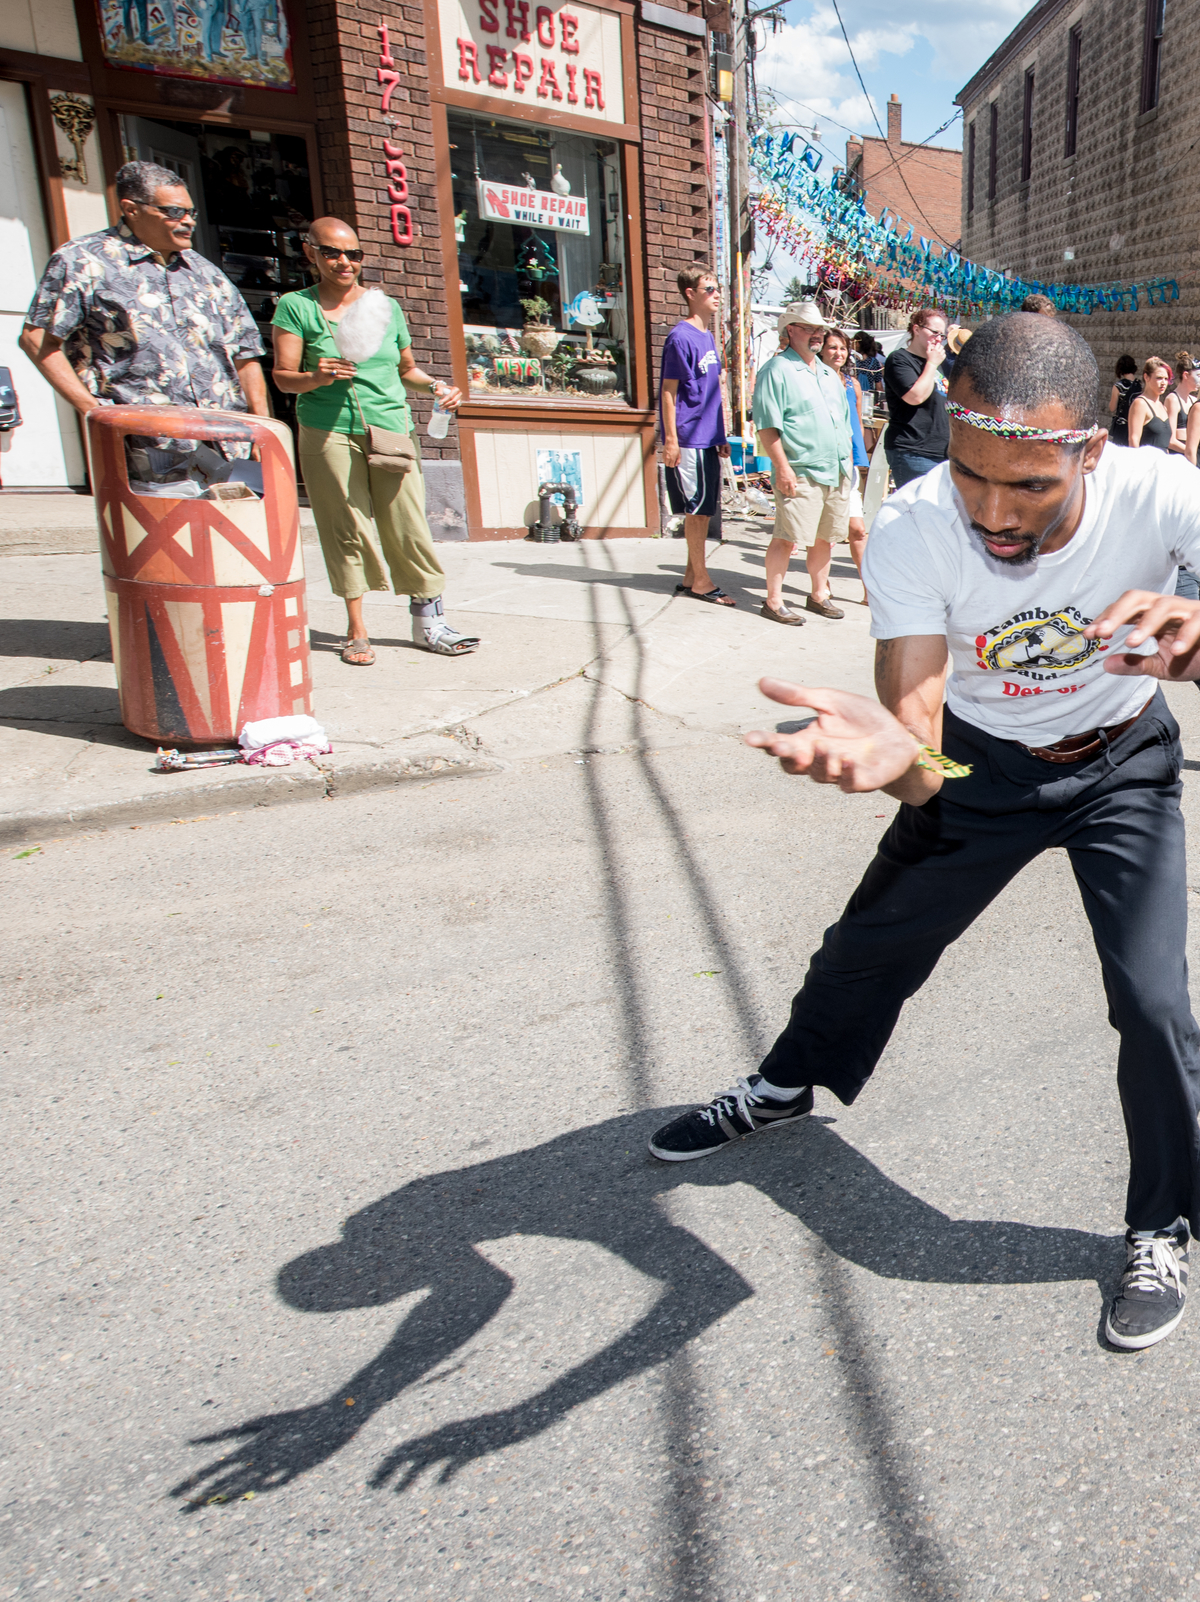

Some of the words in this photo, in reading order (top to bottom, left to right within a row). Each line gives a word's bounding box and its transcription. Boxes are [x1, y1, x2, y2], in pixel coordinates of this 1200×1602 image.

[479, 0, 579, 54] SHOE
[457, 37, 605, 110] REPAIR
[501, 189, 536, 209] SHOE
[540, 195, 587, 217] REPAIR
[514, 209, 544, 223] WHILE
[548, 215, 554, 225] U
[558, 216, 581, 229] WAIT
[495, 357, 541, 377] KEYS
[574, 346, 617, 365] USA
[1002, 680, 1086, 697] Detoi
